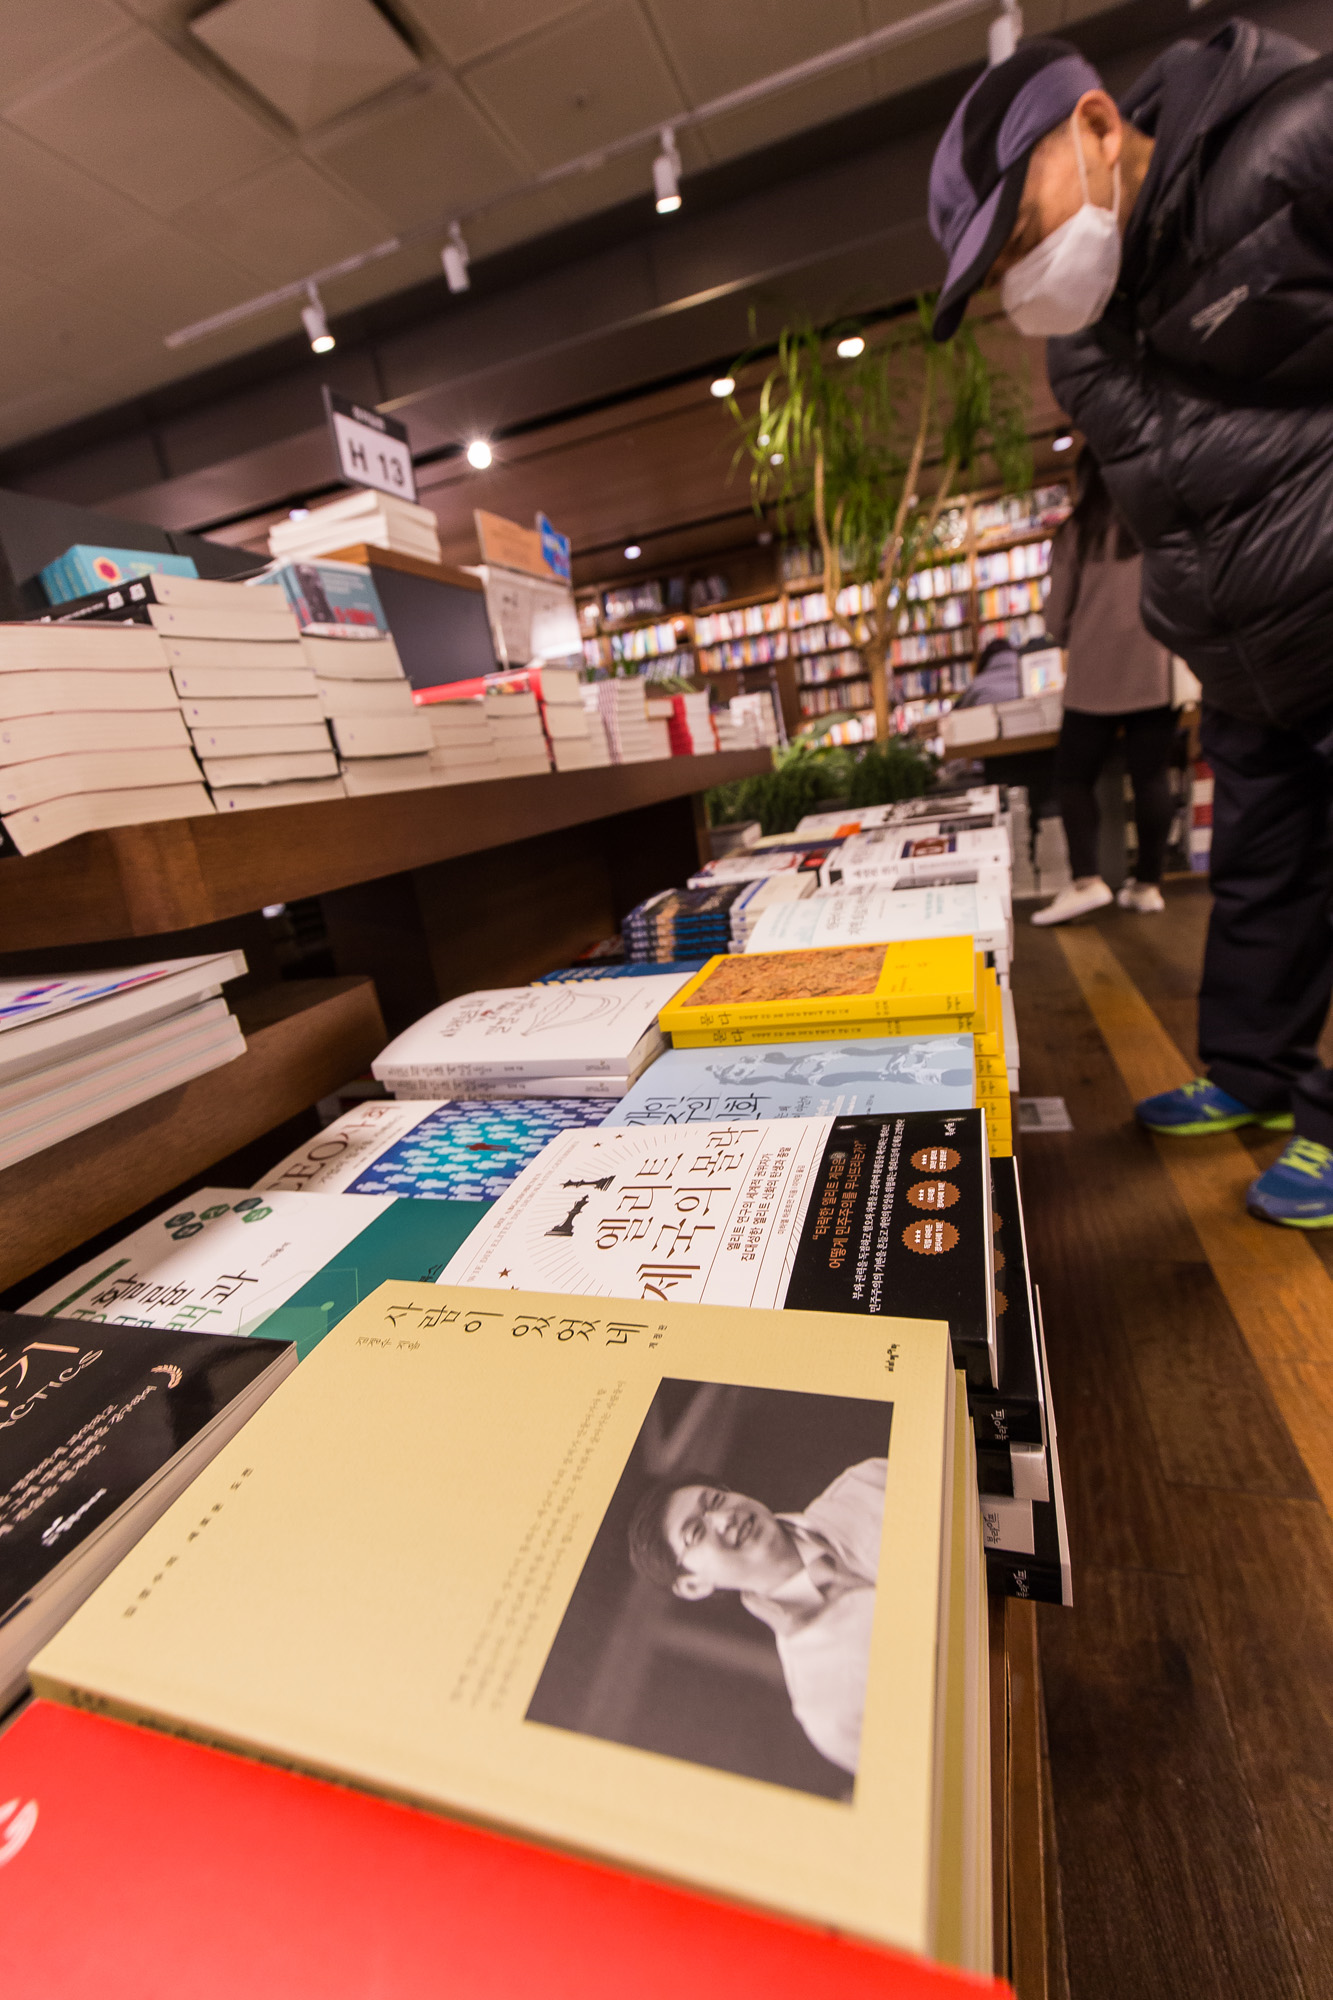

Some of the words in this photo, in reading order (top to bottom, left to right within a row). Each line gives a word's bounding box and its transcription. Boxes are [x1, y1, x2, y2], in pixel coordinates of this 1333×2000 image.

[348, 438, 369, 473] H
[376, 452, 405, 487] 13
[776, 1146, 791, 1157] 종말
[753, 1153, 773, 1177] 권위자가
[768, 1159, 786, 1177] 탄생과
[827, 1157, 846, 1179] 계급은
[744, 1178, 764, 1199] 세계적
[760, 1179, 779, 1199] 신화의
[820, 1181, 840, 1205] 엘리트
[595, 1153, 684, 1250] 엘리트
[735, 1201, 755, 1223] 연구의
[751, 1201, 772, 1224] 엘리트
[833, 1191, 858, 1235] 민주주의를
[636, 1185, 732, 1302] 제국의
[689, 1126, 760, 1180] 몰락
[724, 1225, 747, 1250] 엘리트
[738, 1226, 765, 1261] 집대성한
[858, 1232, 873, 1259] 독점하고
[877, 1229, 890, 1249] 흔들고
[826, 1237, 849, 1268] 어떻게
[874, 1250, 887, 1271] 기반을
[854, 1260, 868, 1281] 권력을
[851, 1283, 865, 1299] 부와
[868, 1272, 884, 1312] 민주주의의
[385, 1302, 504, 1333] 사람이
[511, 1313, 648, 1346] 있었네
